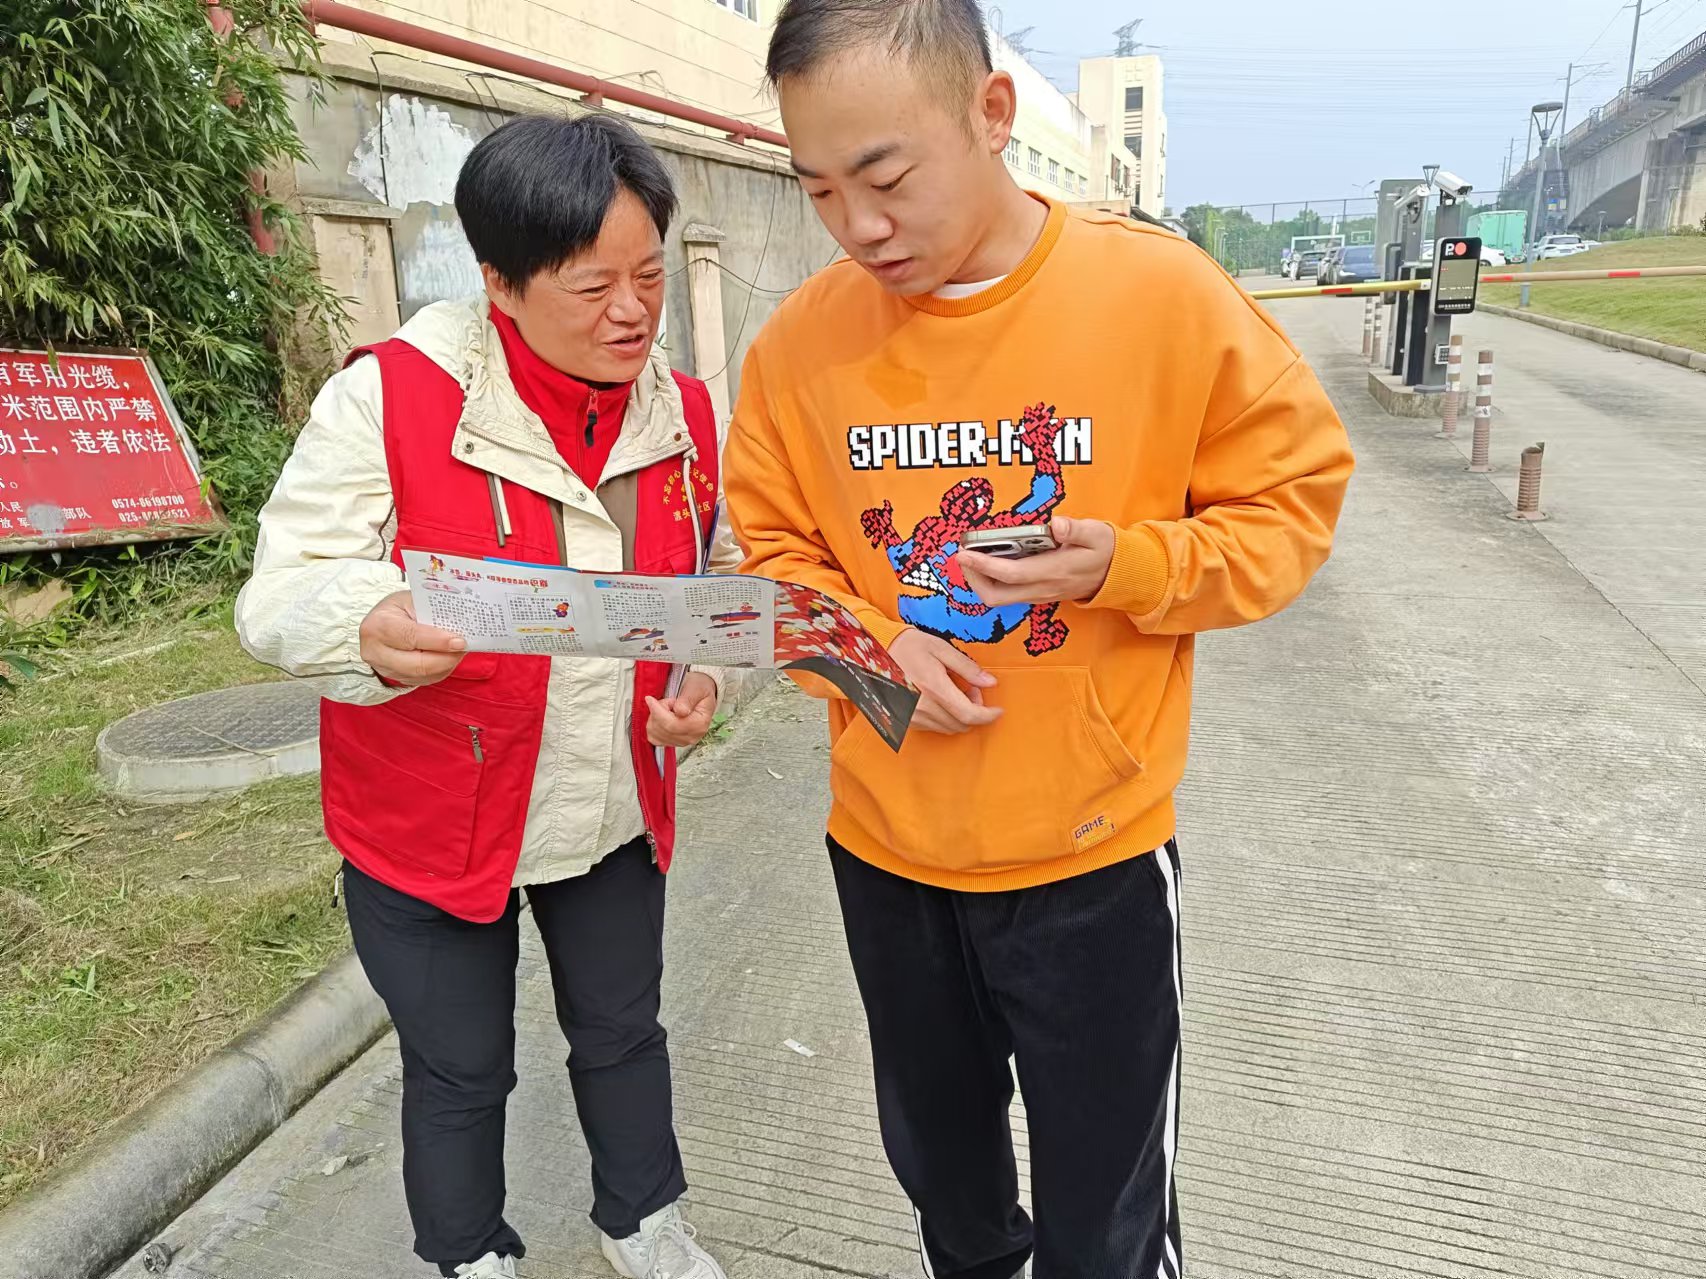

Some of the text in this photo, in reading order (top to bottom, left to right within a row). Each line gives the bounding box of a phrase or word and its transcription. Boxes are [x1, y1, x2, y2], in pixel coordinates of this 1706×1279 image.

[2, 396, 157, 422] 米范围内严禁
[847, 417, 1092, 470] SPIDER-MN
[663, 468, 714, 505] 不忘初心记使命
[1075, 815, 1105, 839] GAME
